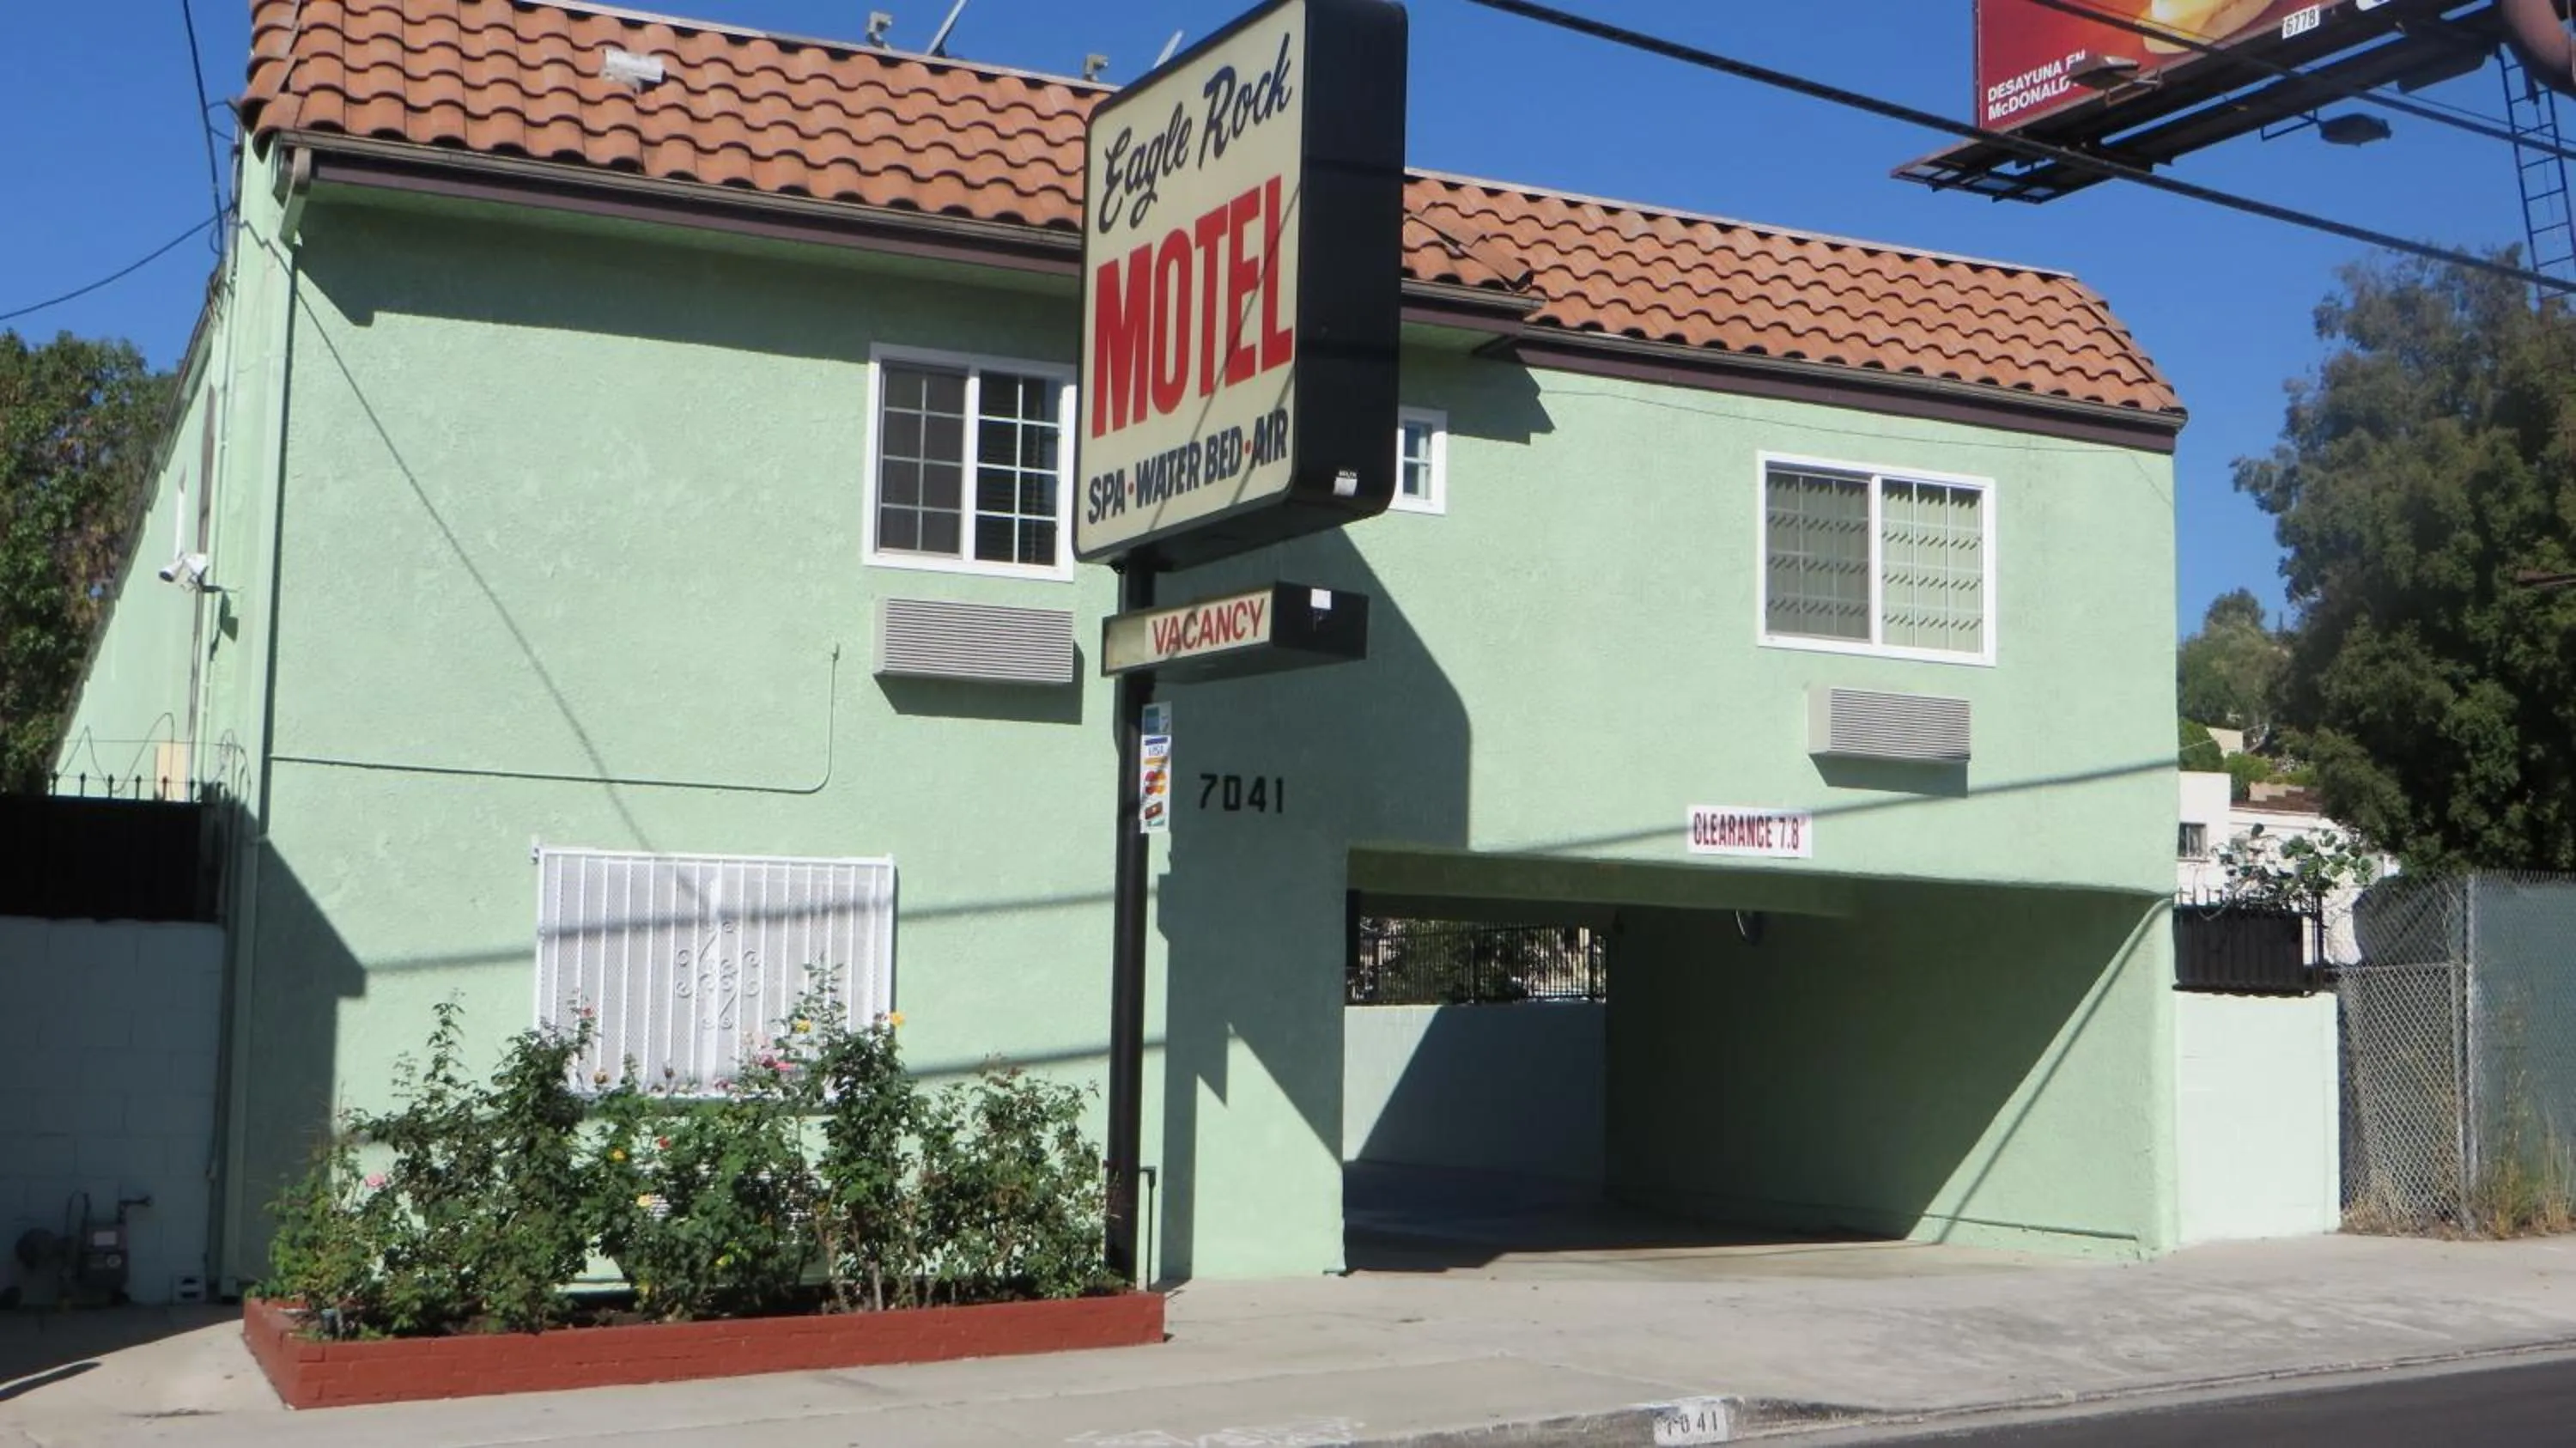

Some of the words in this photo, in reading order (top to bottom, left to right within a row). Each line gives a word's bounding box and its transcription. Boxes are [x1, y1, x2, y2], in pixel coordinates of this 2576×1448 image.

[2285, 9, 2317, 35] 6778
[1988, 59, 2063, 102] DESAYUNA
[1988, 75, 2076, 120] McDONALD
[1099, 100, 1193, 234] Eagle
[1198, 32, 1292, 171] Rock
[1091, 173, 1294, 440] MOTEL
[1088, 468, 1126, 526] SPA
[1136, 440, 1202, 508] WATER
[1204, 425, 1243, 486] BED
[1251, 408, 1289, 470] AIR
[1151, 598, 1265, 655] VACANCY
[1199, 773, 1284, 813] 7041
[1693, 812, 1773, 849] CLEARANCE
[1662, 1410, 1718, 1436] 7041
